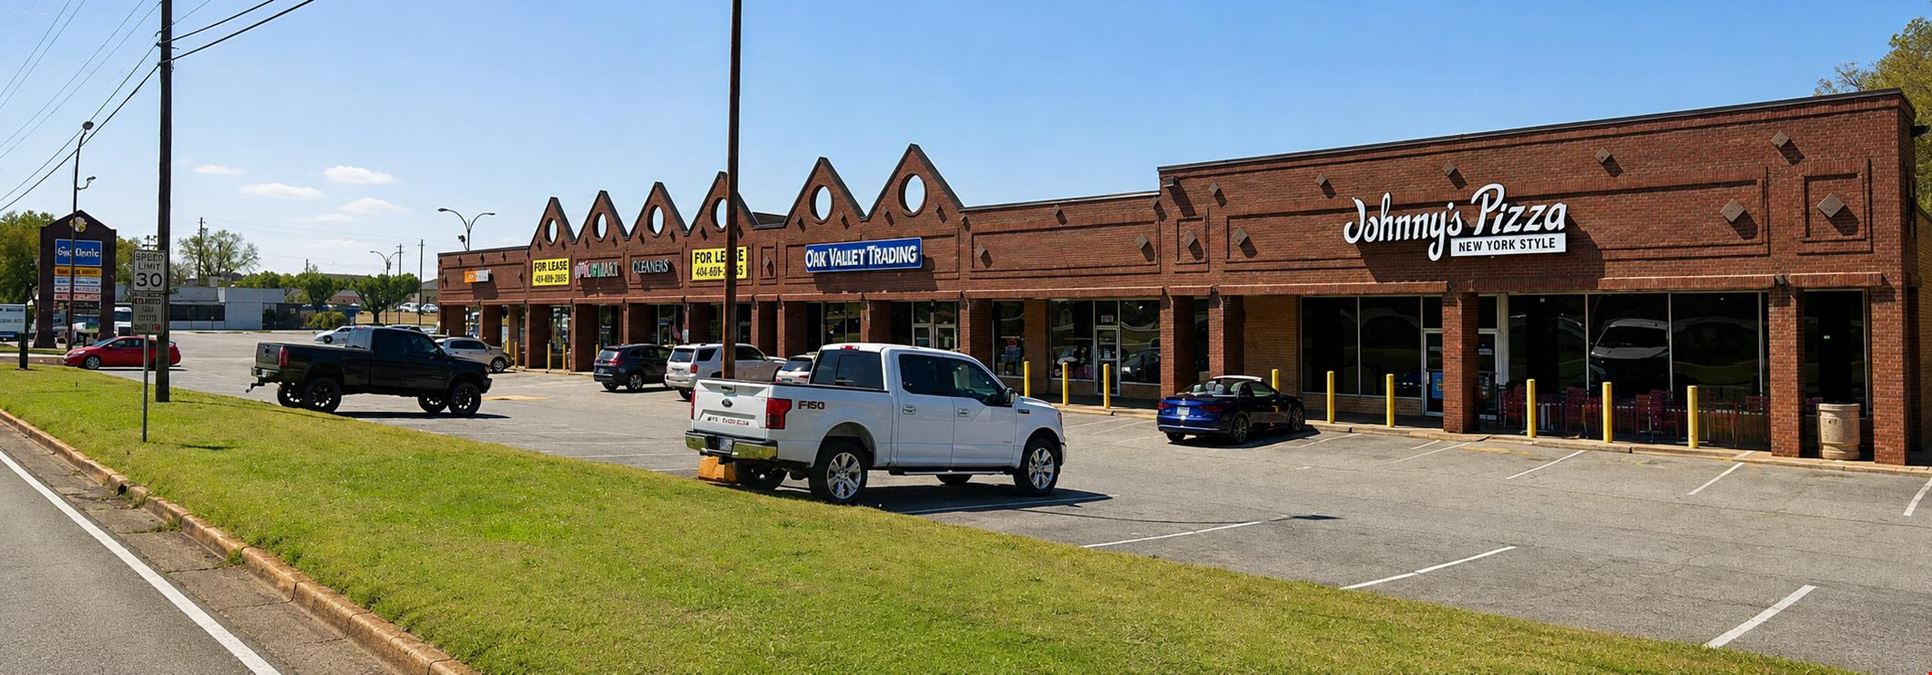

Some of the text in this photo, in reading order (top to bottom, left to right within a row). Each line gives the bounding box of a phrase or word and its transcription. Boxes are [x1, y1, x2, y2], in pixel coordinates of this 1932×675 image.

[1343, 182, 1567, 262] Johnny's Pizza
[1458, 237, 1556, 252] NEW YORK STYLE
[136, 253, 163, 262] SPEED
[694, 249, 744, 264] FOR LEE
[805, 244, 917, 268] OAK VALLEY TRADING
[138, 263, 160, 271] LIMIT
[534, 261, 547, 272] FOR
[548, 260, 568, 271] LEASE
[632, 259, 669, 274] CLEANERS
[136, 272, 163, 287] 30
